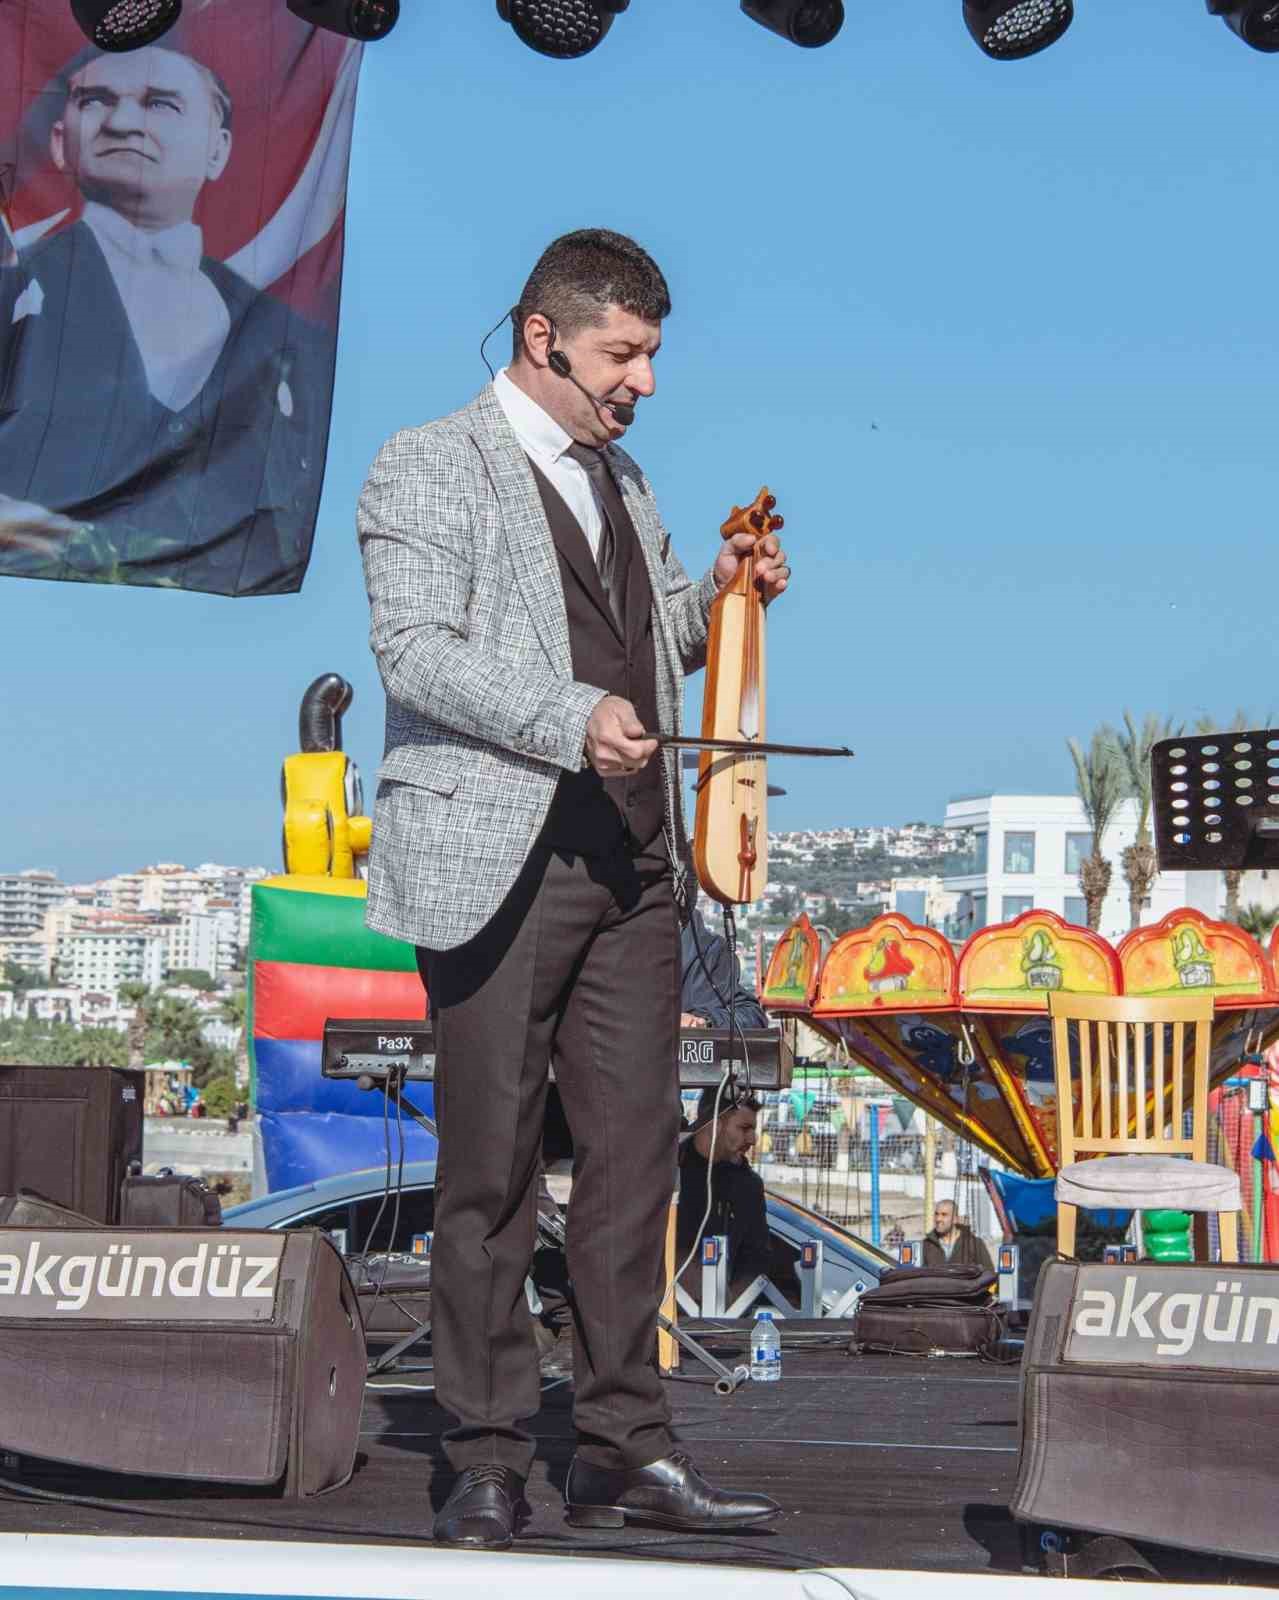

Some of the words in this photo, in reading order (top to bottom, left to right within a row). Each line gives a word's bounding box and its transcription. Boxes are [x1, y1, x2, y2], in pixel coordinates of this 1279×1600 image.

[377, 1036, 414, 1050] Pa3X
[678, 1040, 714, 1063] RG
[0, 1241, 279, 1311] akgündüz
[1075, 1275, 1279, 1356] akgün
